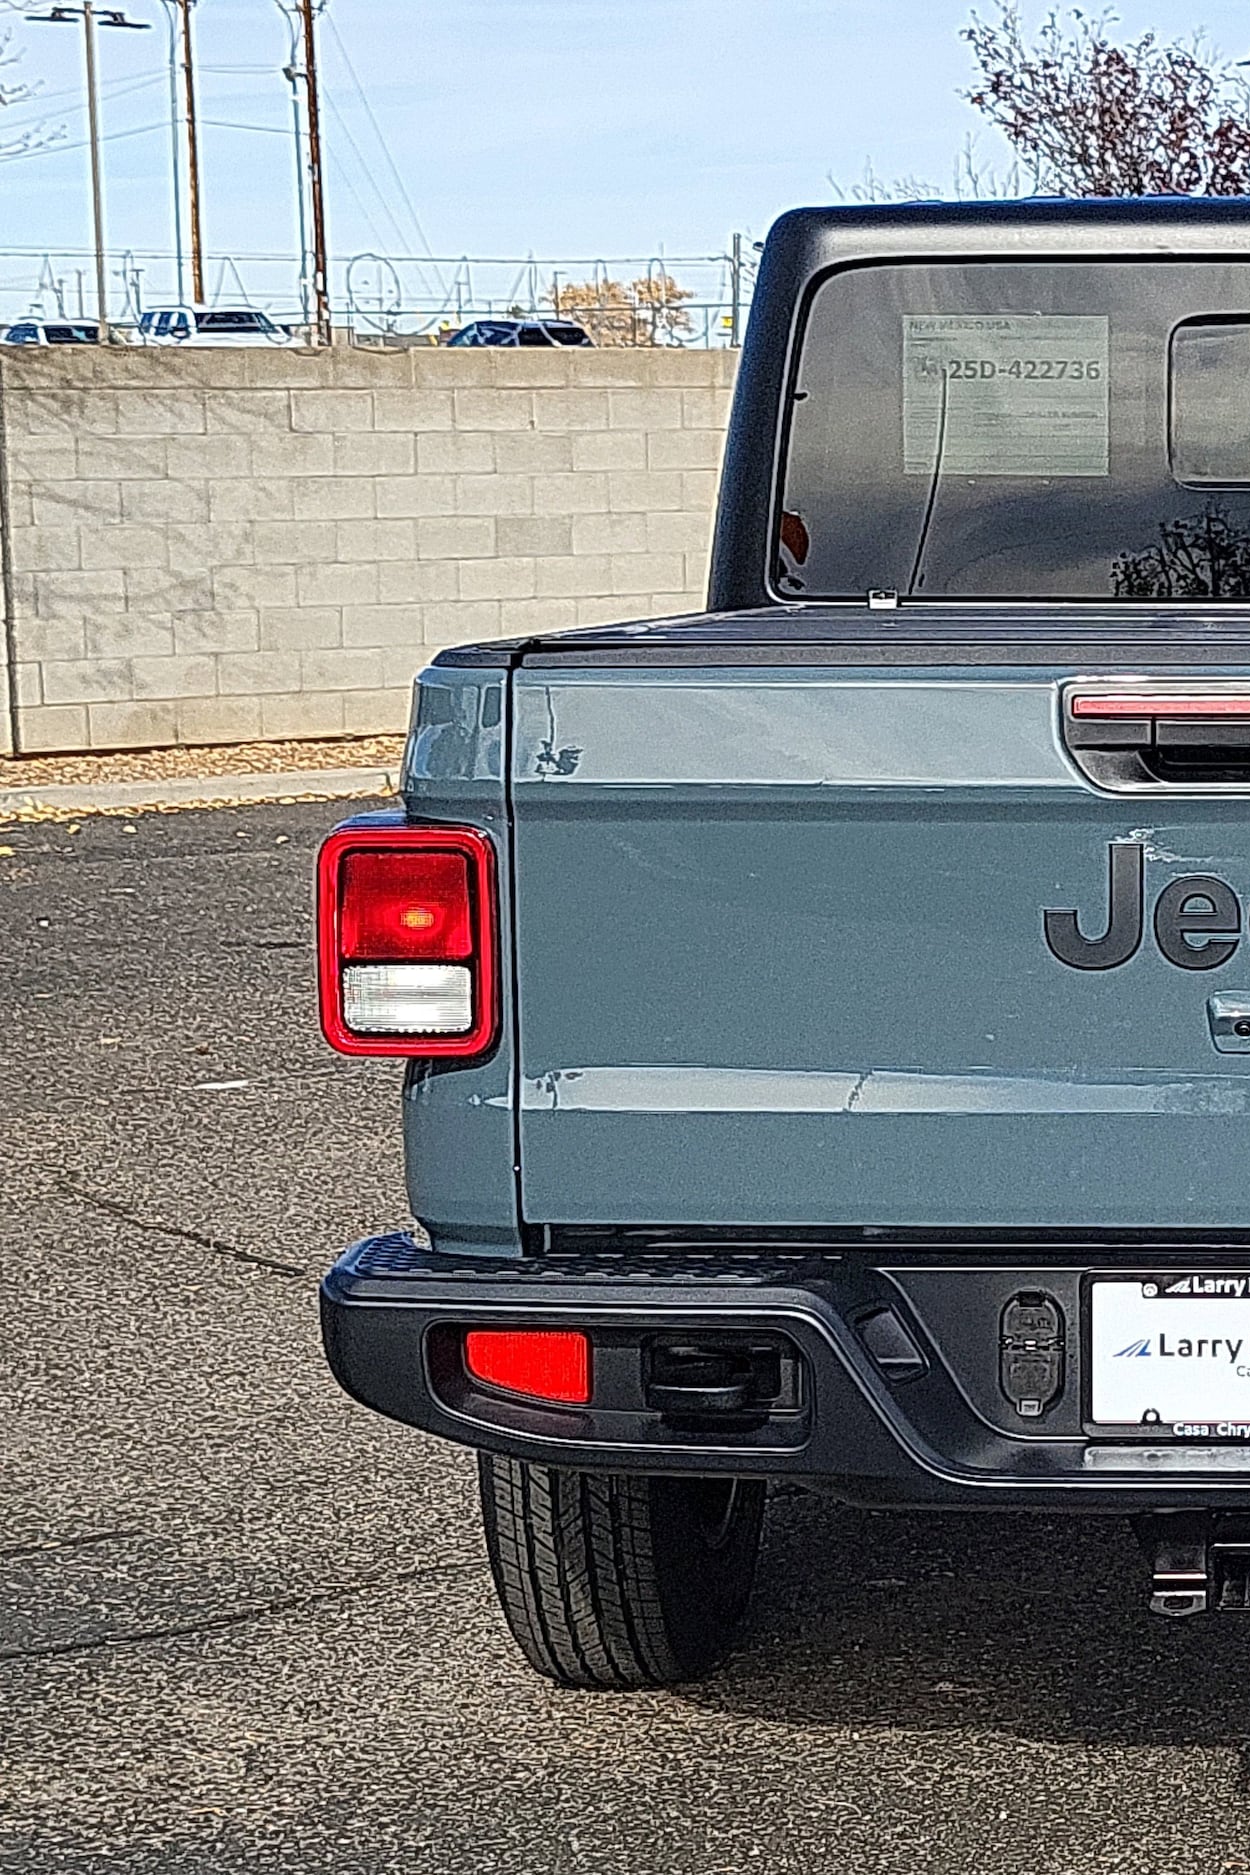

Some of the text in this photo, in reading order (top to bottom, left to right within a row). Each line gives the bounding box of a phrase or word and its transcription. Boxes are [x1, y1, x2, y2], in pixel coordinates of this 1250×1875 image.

[949, 360, 1101, 380] 25D-422736
[1193, 1276, 1247, 1297] Larry
[1159, 1333, 1243, 1364] Larry
[1173, 1422, 1209, 1437] Casa
